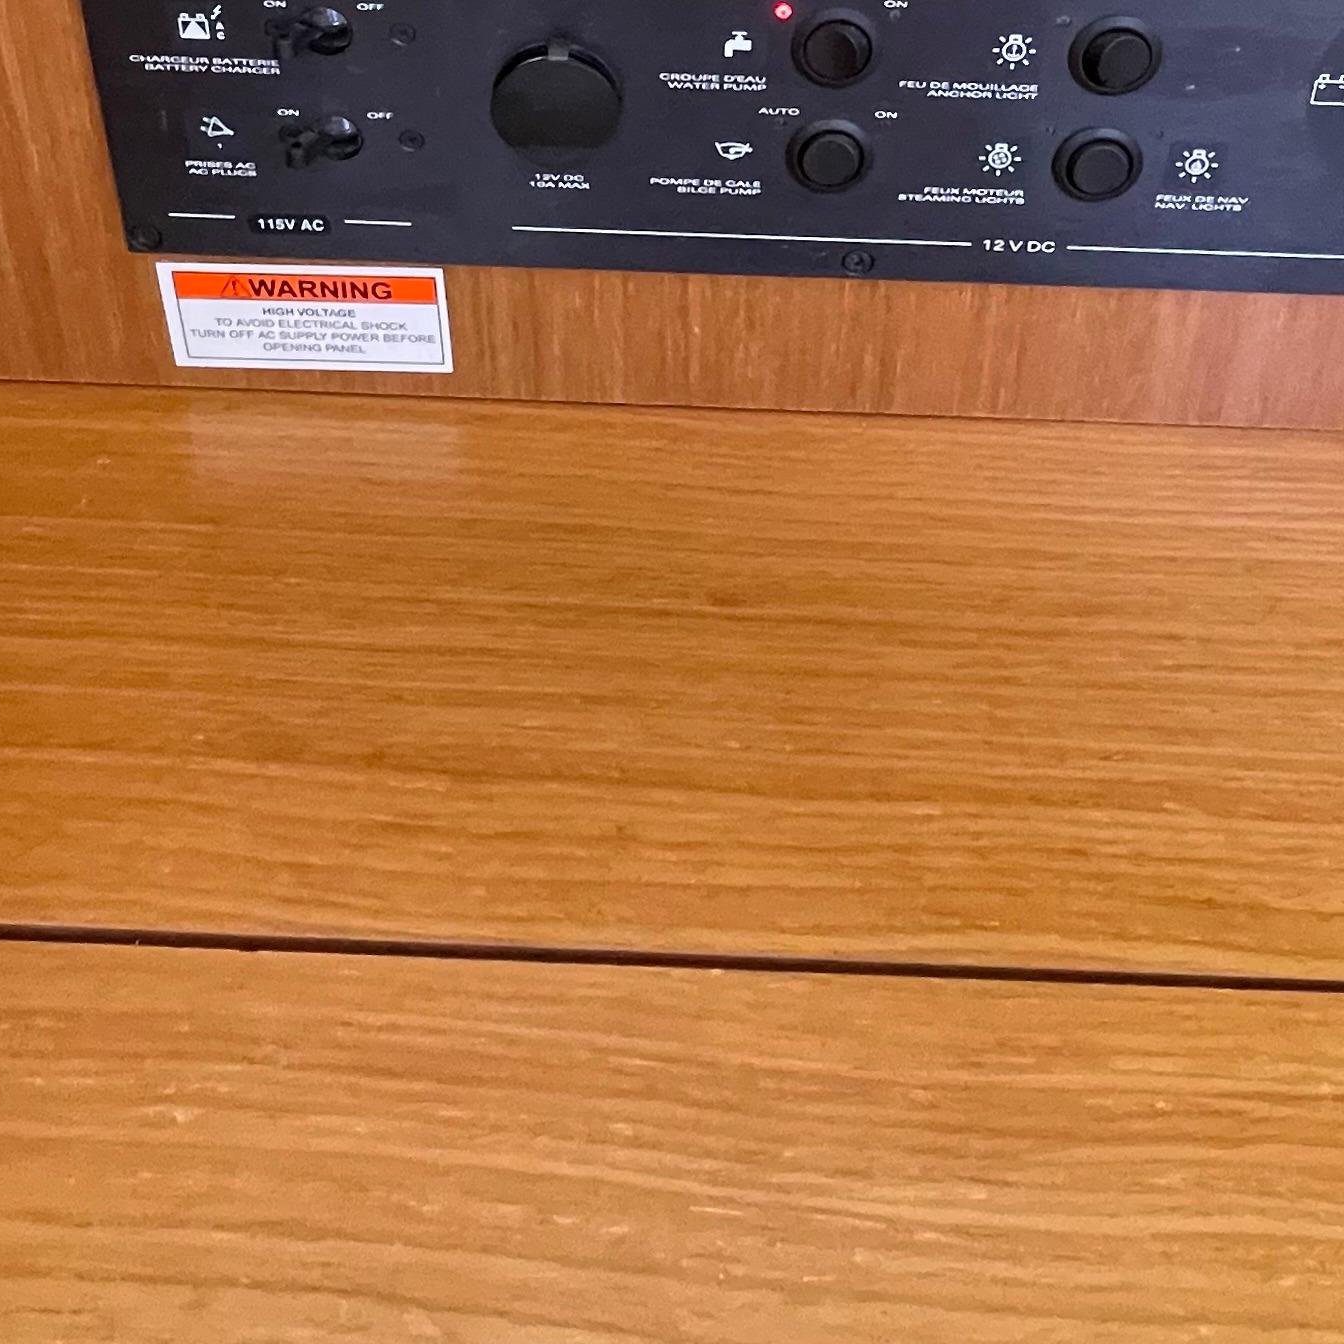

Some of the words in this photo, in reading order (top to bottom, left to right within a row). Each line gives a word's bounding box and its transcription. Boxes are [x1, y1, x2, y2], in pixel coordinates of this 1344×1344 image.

[263, 0, 286, 8] ON
[356, 2, 384, 11] OFF
[884, 0, 908, 9] ON
[129, 55, 209, 64] CHARGEUR
[212, 58, 279, 66] BATTERIE
[145, 63, 208, 72] BATTERY
[211, 65, 281, 75] CHARGER
[659, 72, 720, 83] GROUPE
[723, 74, 766, 84] D'EAU
[667, 81, 720, 91] WATER
[723, 82, 767, 92] PUMP
[899, 80, 926, 89] FEU
[929, 81, 950, 91] DE
[953, 82, 1038, 93] MOUILLAGE
[927, 89, 992, 99] ANCHOR
[995, 91, 1038, 101] LIGHT
[277, 108, 300, 117] ON
[367, 111, 394, 120] OFF
[758, 107, 800, 116] AUTO
[874, 110, 898, 120] ON
[235, 161, 256, 170] AC
[189, 168, 209, 176] AC
[564, 174, 584, 182] DC
[649, 177, 700, 186] POMPE
[704, 178, 723, 188] DE
[726, 179, 761, 189] CALE
[677, 185, 717, 195] BILGE
[720, 186, 762, 196] PUMP
[923, 186, 959, 196] FEUX
[963, 188, 1024, 198] MOTEUR
[898, 194, 972, 204] STEAMING
[975, 195, 1025, 205] LIGHTS
[1156, 194, 1191, 202] FEUX
[257, 218, 295, 231] 115V
[300, 219, 325, 232] AC
[248, 278, 393, 299] WARNING
[262, 307, 294, 316] HIGH
[297, 308, 356, 318] VOLTAGE
[215, 318, 232, 326] TO
[236, 319, 275, 328] AVOID
[278, 319, 356, 329] ELECTRICAL
[361, 321, 407, 330] SHOCK
[189, 329, 225, 338] TURN
[229, 330, 253, 339] OFF
[258, 330, 276, 339] AC
[279, 331, 327, 341] SUPPLY
[331, 332, 379, 342] POWER
[383, 334, 436, 344] BEFORE
[263, 343, 322, 352] OPENING
[325, 344, 365, 353] PANEL
